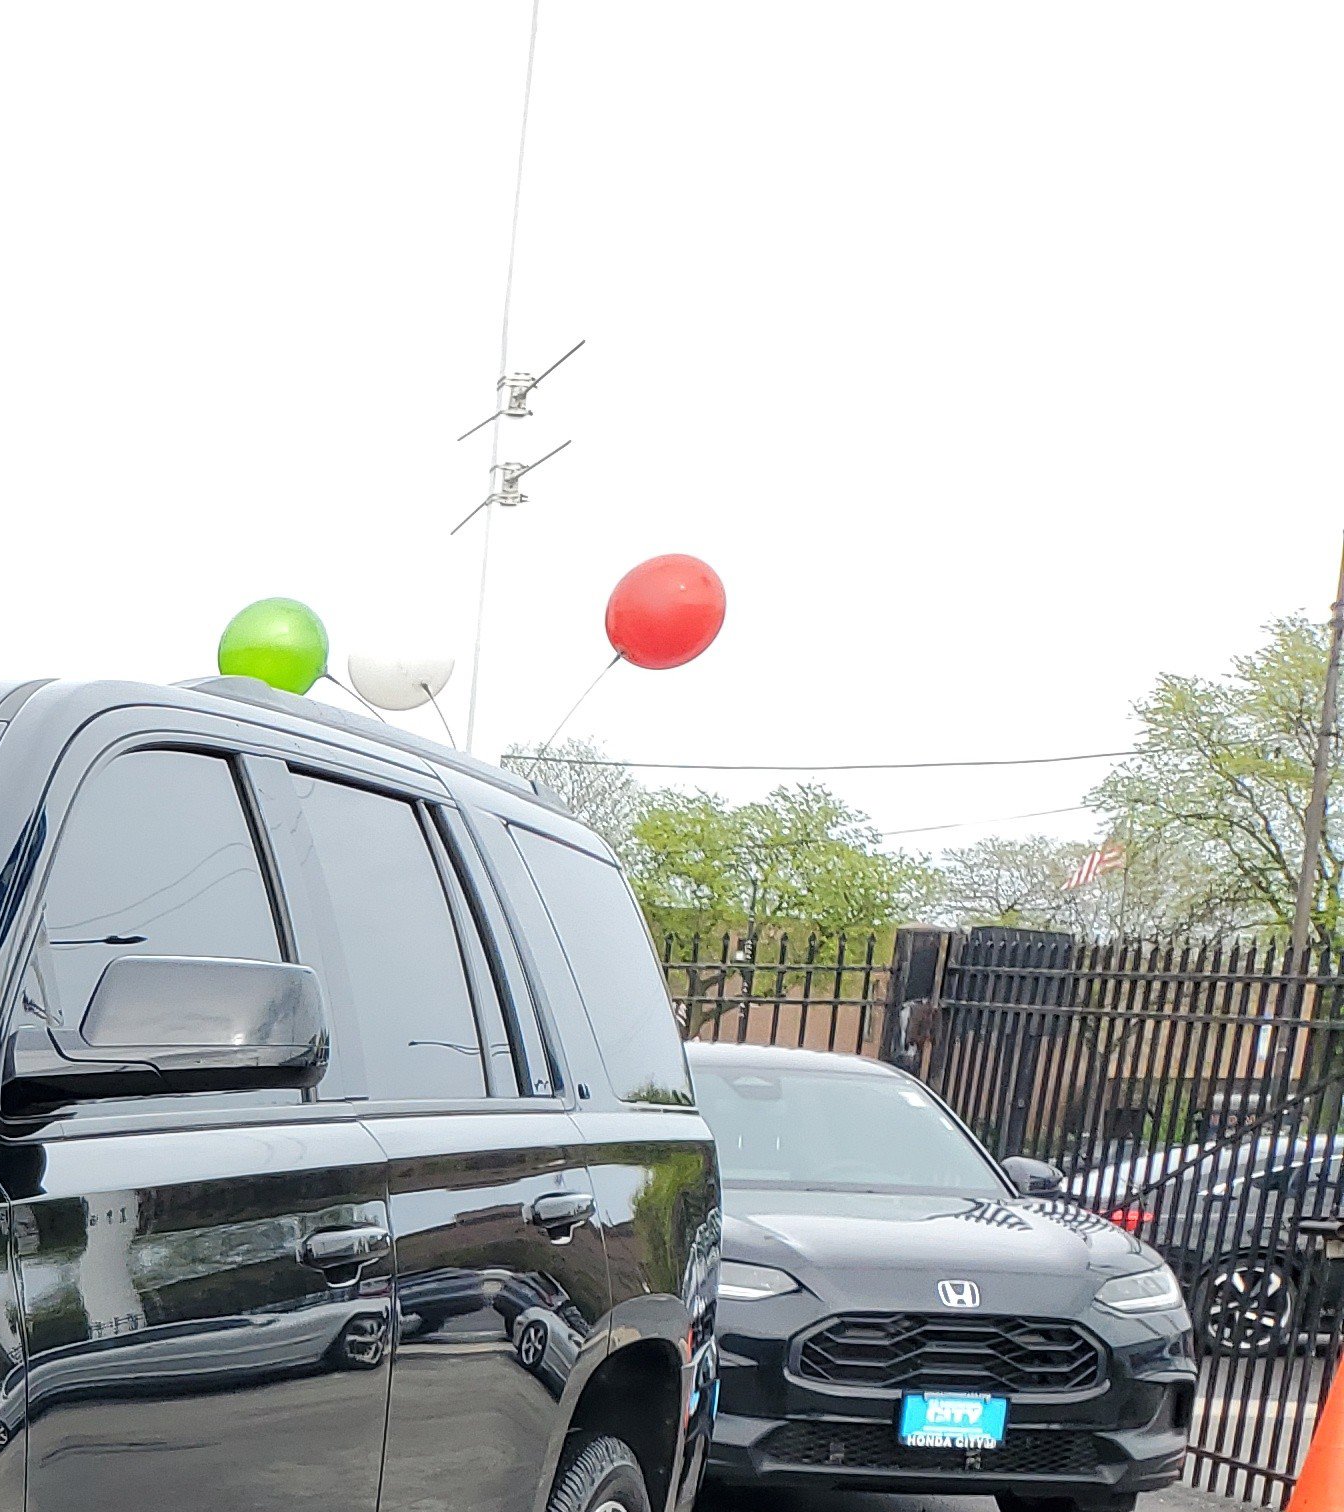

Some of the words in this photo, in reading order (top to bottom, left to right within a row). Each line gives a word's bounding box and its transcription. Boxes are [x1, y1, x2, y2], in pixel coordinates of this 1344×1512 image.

[926, 1405, 983, 1425] CITY
[906, 1433, 952, 1447] HONDA
[955, 1434, 984, 1449] CITY
